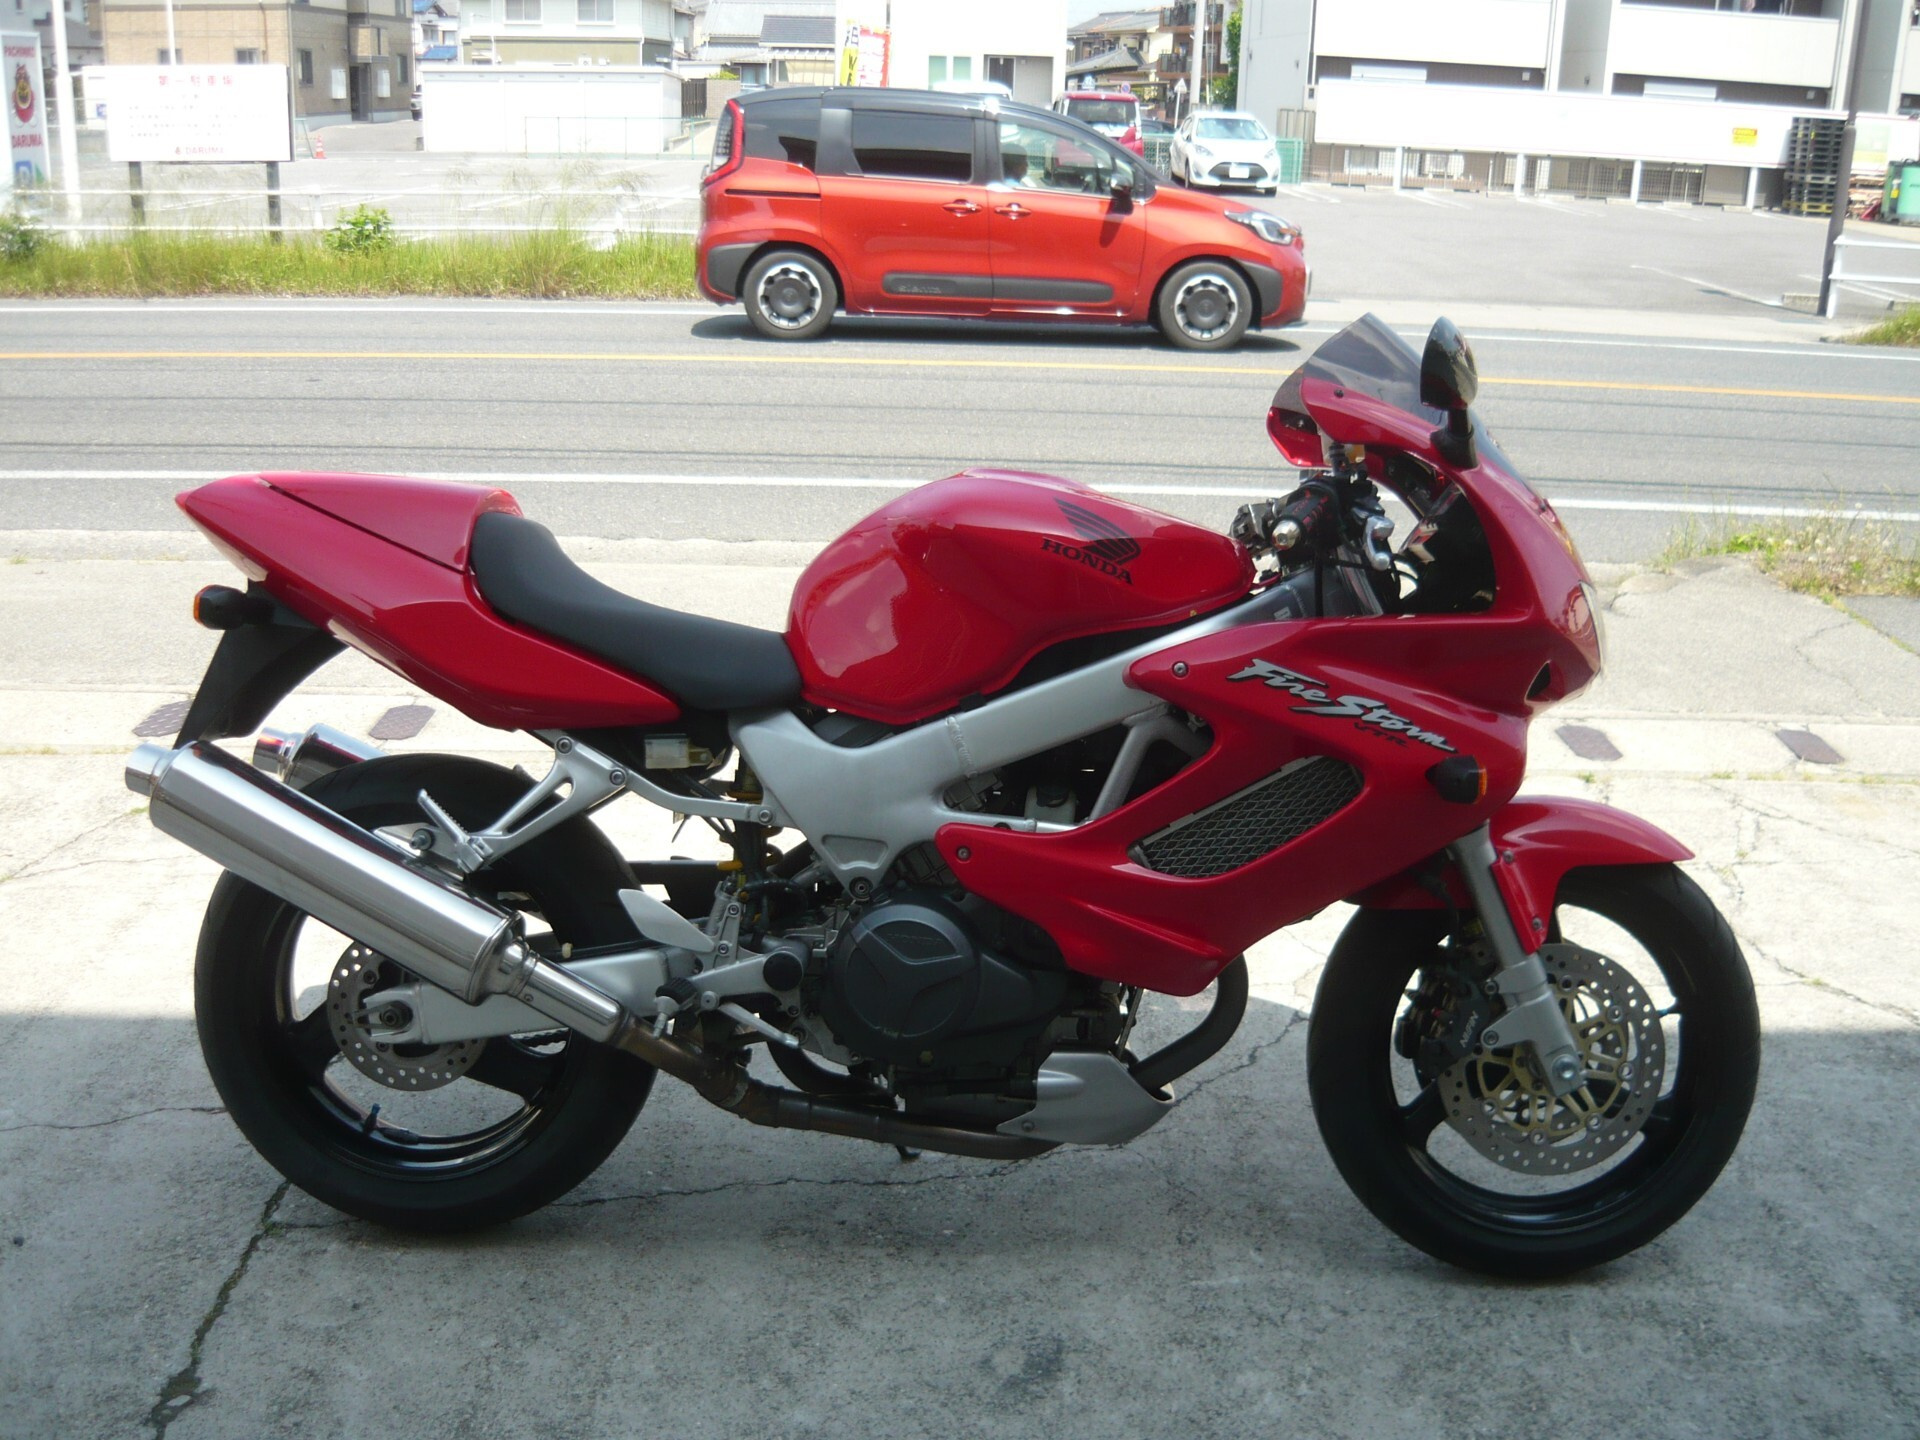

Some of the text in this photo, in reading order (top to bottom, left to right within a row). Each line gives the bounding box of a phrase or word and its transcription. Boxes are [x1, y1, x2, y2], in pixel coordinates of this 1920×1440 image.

[11, 134, 43, 148] DARUMA
[185, 146, 224, 154] DARUMA
[1040, 538, 1133, 585] HONDA
[1225, 658, 1458, 752] Fire Storm
[1353, 722, 1410, 748] VTR
